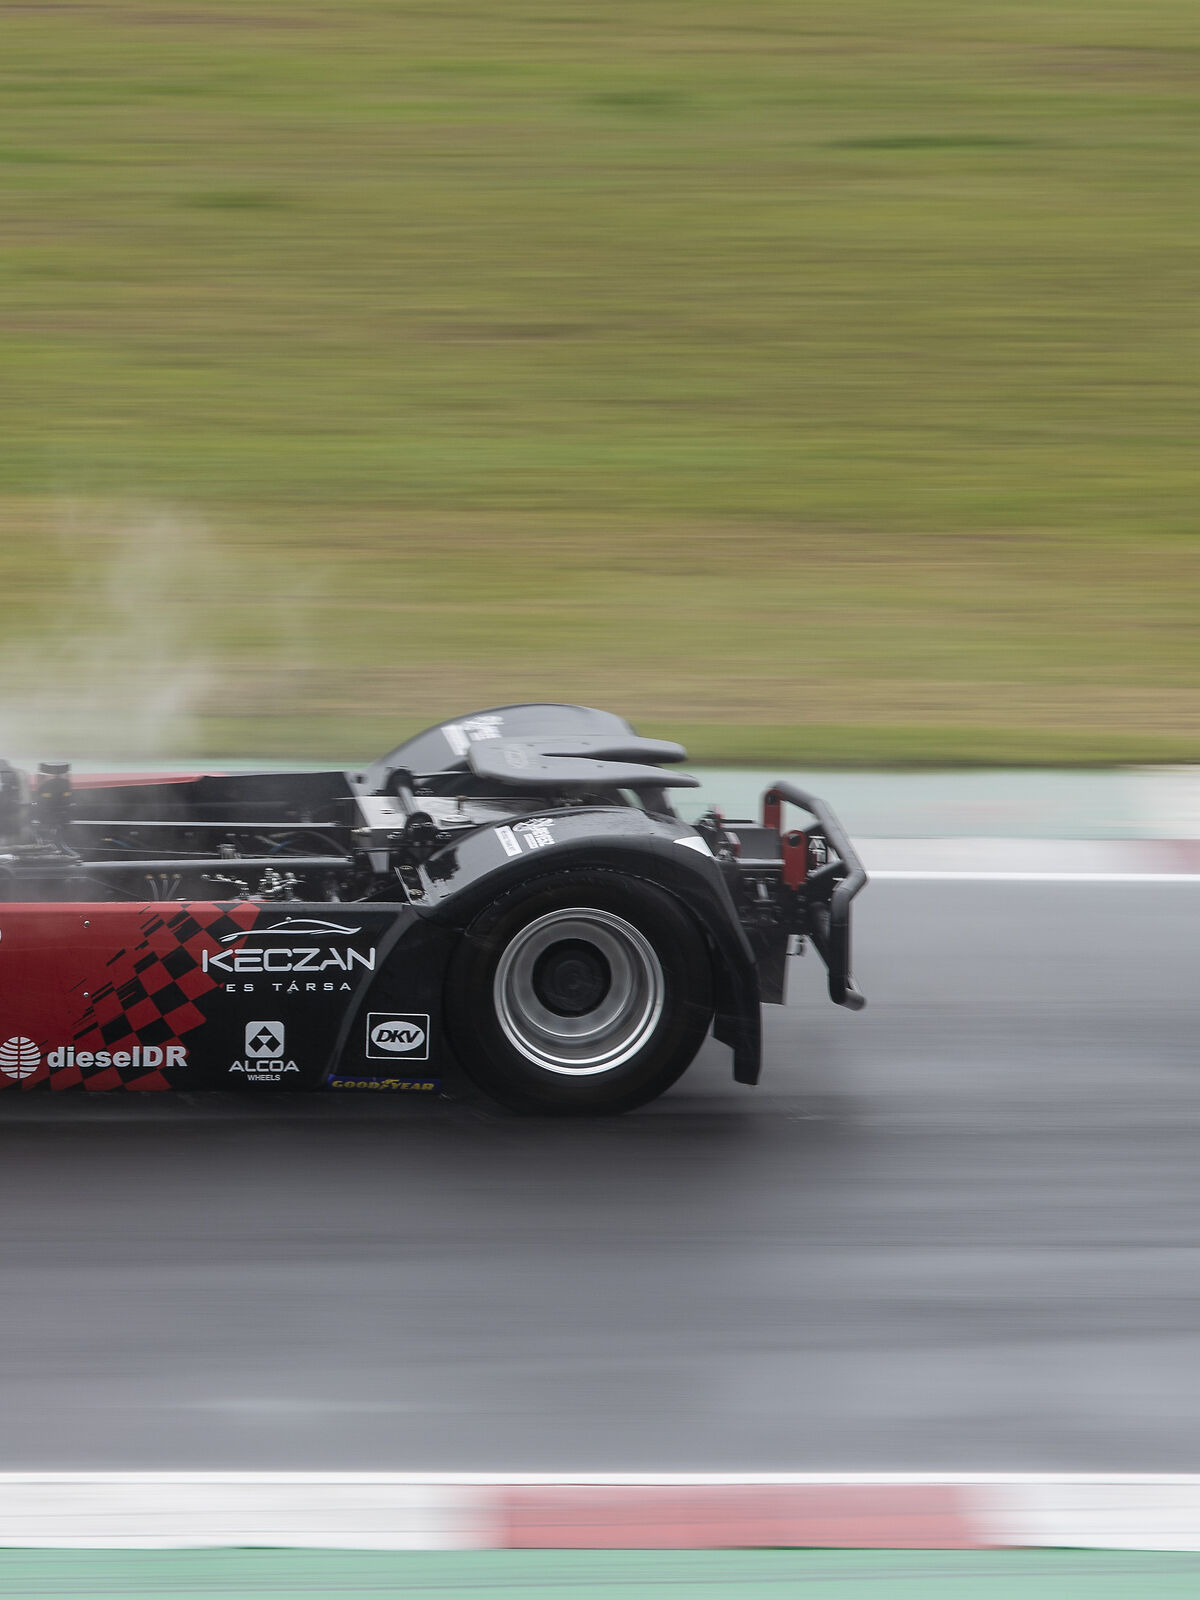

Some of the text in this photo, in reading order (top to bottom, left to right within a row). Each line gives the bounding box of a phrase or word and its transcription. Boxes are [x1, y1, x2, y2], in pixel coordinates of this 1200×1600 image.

[202, 947, 376, 972] KECZAN
[272, 980, 352, 991] TÁRSA
[376, 1029, 420, 1043] DKV
[47, 1045, 188, 1067] dieselDR
[228, 1060, 300, 1072] ALCOA
[332, 1079, 435, 1091] GOODYEAR
